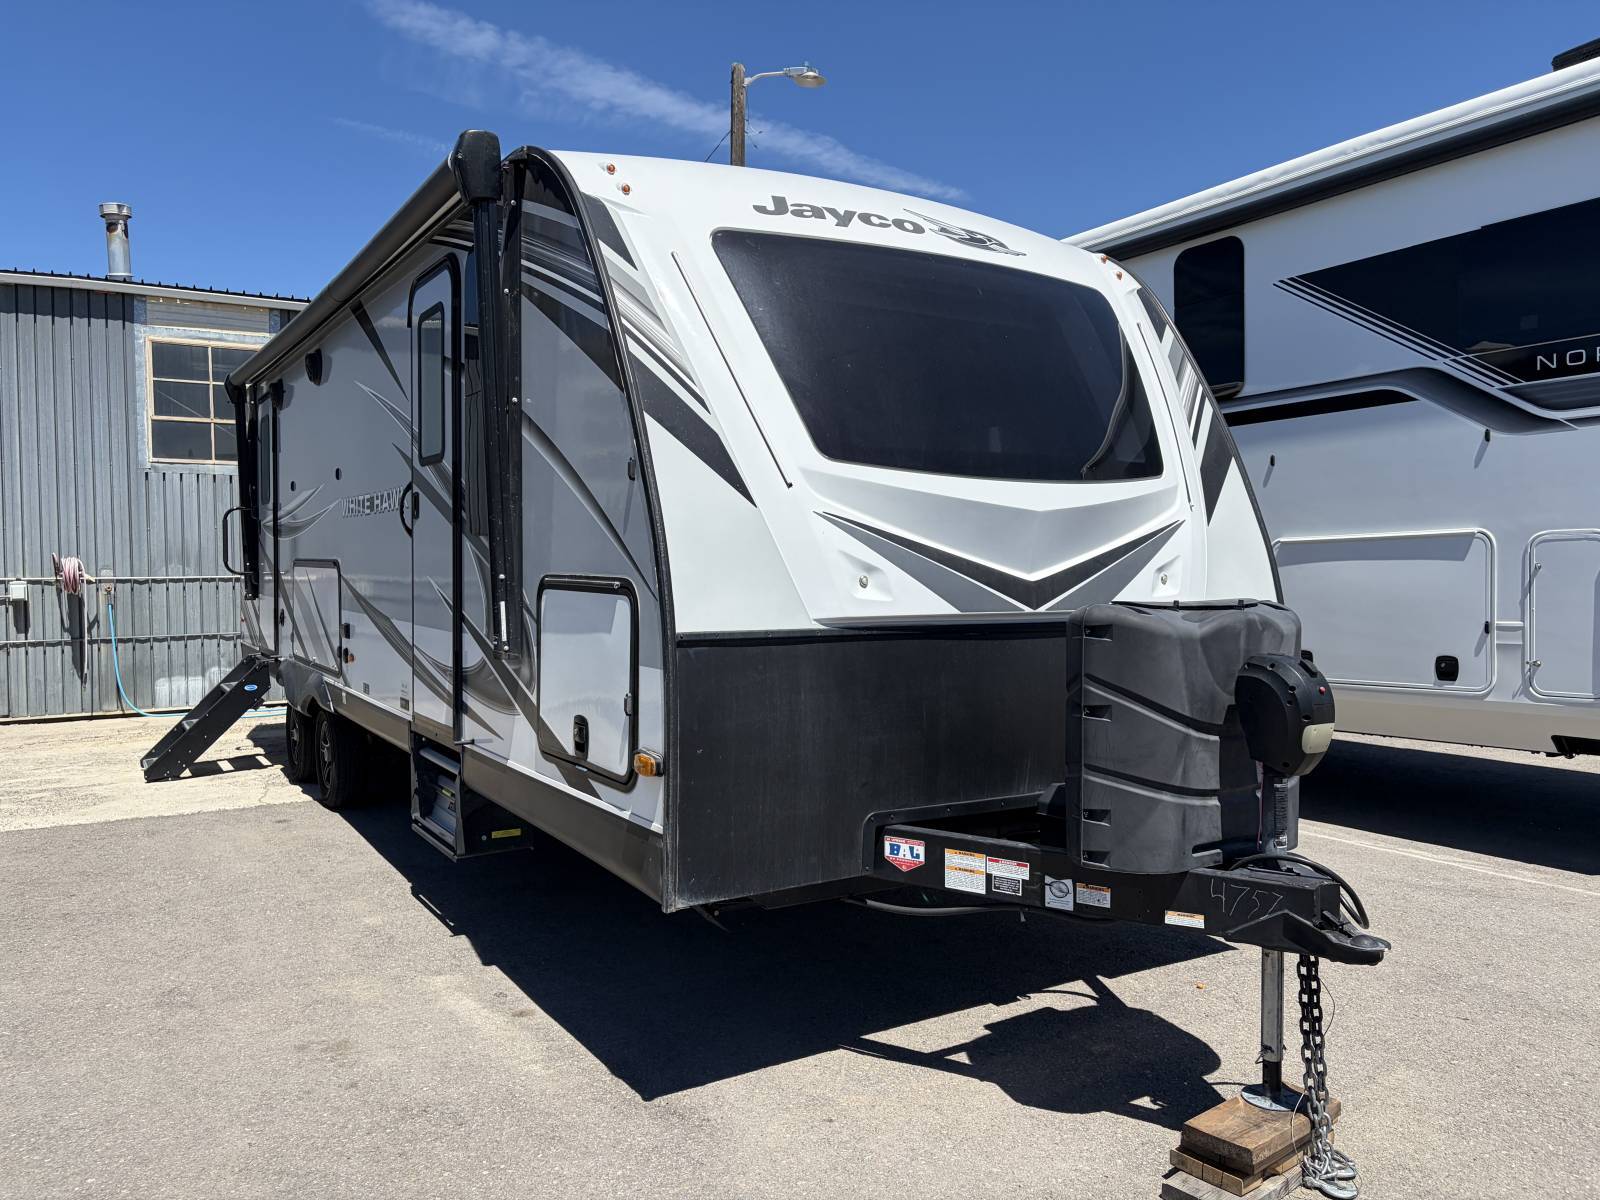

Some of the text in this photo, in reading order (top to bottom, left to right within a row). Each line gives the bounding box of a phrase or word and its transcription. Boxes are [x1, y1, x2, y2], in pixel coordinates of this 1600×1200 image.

[753, 195, 926, 235] Jayco
[1536, 346, 1600, 371] NO
[341, 494, 371, 516] WHITE
[1210, 878, 1284, 919] 4757
